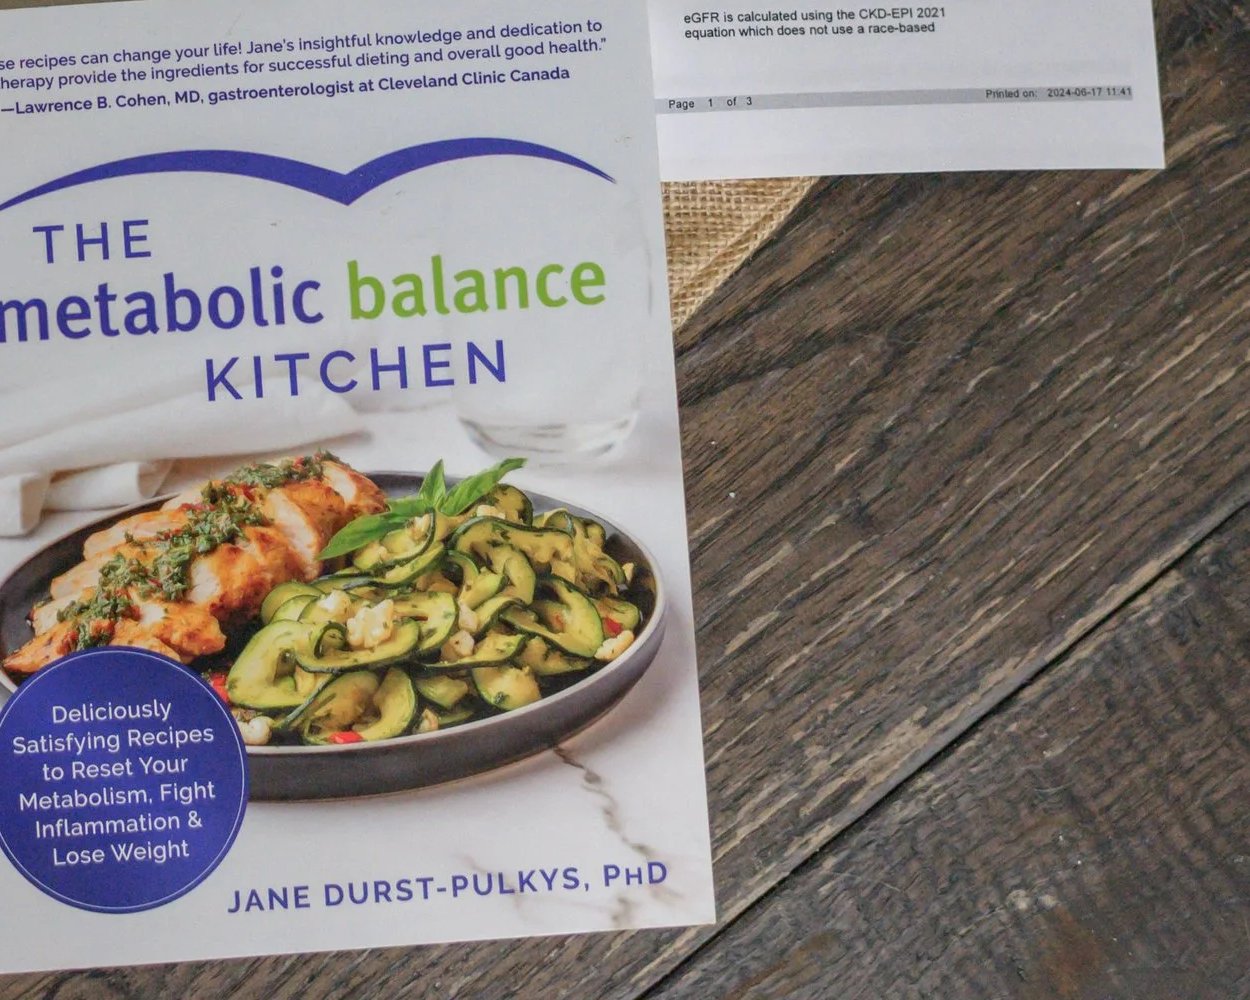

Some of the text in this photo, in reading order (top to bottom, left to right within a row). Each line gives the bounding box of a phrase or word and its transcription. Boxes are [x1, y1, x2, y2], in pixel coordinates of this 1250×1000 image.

[683, 6, 945, 24] eGFR is calculated using the CKD-EPI 2021
[684, 21, 935, 40] equation which does not use a race-based
[19, 53, 77, 71] recipes
[79, 52, 109, 65] can
[112, 48, 171, 64] change
[174, 46, 210, 63] your
[212, 40, 242, 57] life!
[245, 38, 295, 55] Jane's
[298, 32, 372, 53] insightful
[374, 28, 463, 46] knowledge
[465, 24, 496, 40] and
[499, 20, 583, 38] dedication
[585, 19, 603, 32] to
[57, 69, 117, 89] provide
[120, 67, 147, 82] the
[150, 61, 239, 83] ingredients
[242, 59, 265, 74] for
[268, 53, 353, 72] successful
[354, 50, 410, 67] dieting
[413, 47, 444, 63] and
[446, 43, 501, 61] overall
[503, 41, 545, 61] good
[96, 95, 112, 109] B.
[114, 92, 171, 108] Cohen,
[174, 89, 204, 104] MD,
[207, 79, 355, 106] gastroenterologist
[358, 78, 375, 93] at
[377, 72, 458, 91] Cleveland
[461, 69, 506, 86] Clinic
[509, 65, 570, 82] Canada
[668, 95, 753, 111] Page 1 of 3
[31, 218, 152, 264] THE
[347, 254, 605, 319] balance
[205, 339, 506, 402] KITCHEN
[51, 698, 172, 724] Deliciously
[12, 725, 214, 756] Satisfying Recipes
[41, 755, 189, 781] to Reset Your
[18, 780, 216, 811] Metabolism, Fight
[35, 809, 203, 838] Inflammation &
[52, 838, 190, 866] Lose Weight
[226, 884, 311, 914] JANE
[323, 866, 589, 907] DURST-PULKYS,
